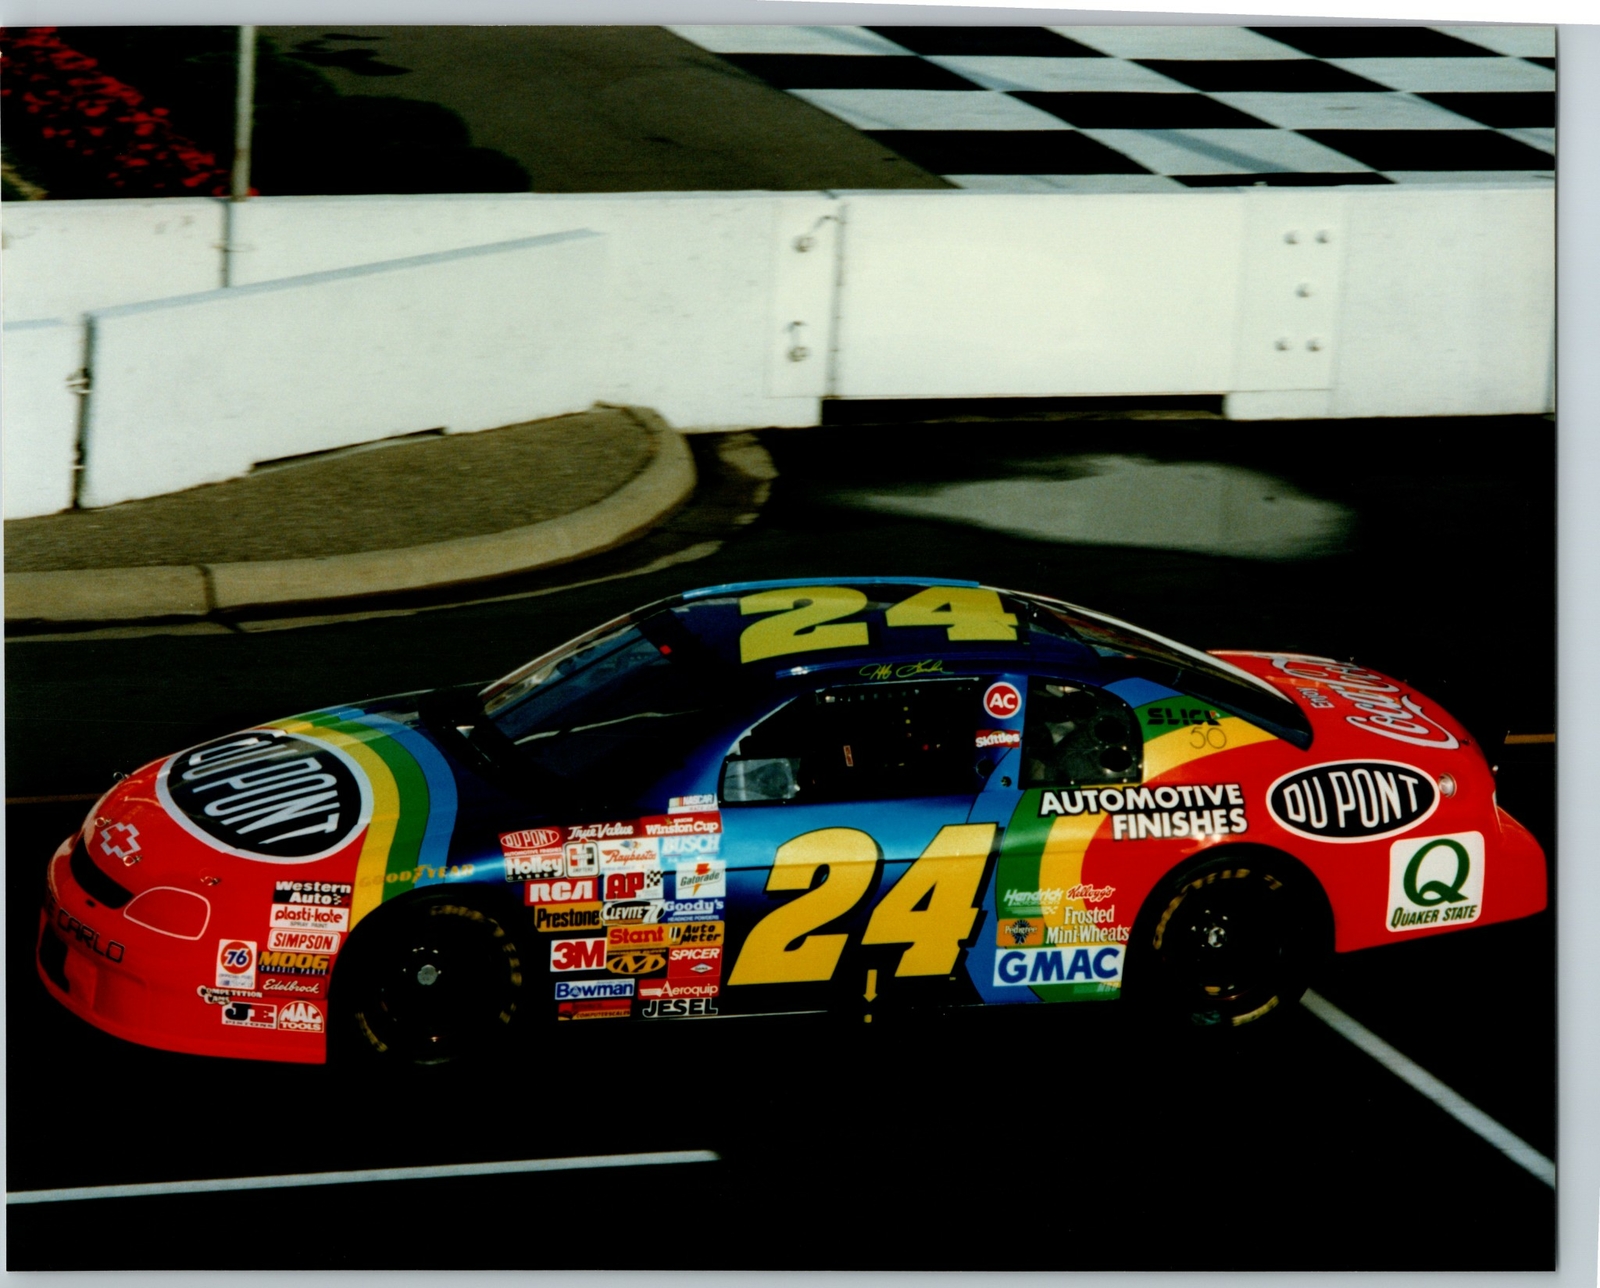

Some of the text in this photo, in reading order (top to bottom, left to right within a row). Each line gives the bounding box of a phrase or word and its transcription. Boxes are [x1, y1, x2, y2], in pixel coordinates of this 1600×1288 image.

[739, 586, 1018, 664] 24
[989, 692, 1017, 709] AC
[1146, 708, 1222, 726] SLICK
[975, 731, 1021, 748] Skittles
[1189, 727, 1227, 750] 50
[182, 737, 341, 845] DU PONT
[683, 794, 714, 804] NASCAR
[1040, 784, 1244, 816] AUTOMOTIVE
[1283, 768, 1419, 829] DU PONT
[567, 822, 633, 840] True Value
[645, 820, 719, 836] Winston Cup
[1113, 808, 1248, 841] FINISHES
[505, 830, 554, 847] DU PONT
[662, 834, 720, 855] BUSCH
[506, 855, 562, 876] Holley
[360, 864, 475, 888] GOODYEAR
[680, 870, 720, 887] Gatorade
[275, 881, 351, 893] Western
[529, 880, 593, 902] RCA
[605, 871, 645, 900] AP
[1066, 884, 1116, 902] Kellogg's
[289, 891, 333, 904] Auto
[727, 822, 997, 985] 24
[1004, 888, 1064, 906] Hendrick
[274, 906, 343, 923] plasti-kote
[602, 899, 665, 923] CLEVITE 77
[665, 899, 724, 915] Goody's
[1064, 905, 1115, 924] Frosted
[1390, 904, 1478, 928] QUAKER STATE
[536, 908, 600, 929] Prestone
[58, 907, 125, 964] CARLO
[610, 926, 664, 944] Stant
[683, 924, 715, 934] Auto
[1004, 925, 1038, 935] Pedigree
[273, 932, 334, 950] SIMPSON
[681, 933, 721, 945] Meter
[223, 949, 250, 967] 76
[258, 951, 330, 969] MOOG
[552, 939, 606, 970] 3M
[670, 947, 720, 960] SPICER
[300, 968, 326, 976] PARTS
[997, 947, 1120, 984] GMAC
[197, 985, 263, 998] COMPETITION
[263, 978, 319, 994] Edelbrock
[556, 983, 634, 998] Bowman
[659, 981, 719, 997] Aeroquip
[224, 1002, 275, 1024] JE
[280, 1002, 322, 1022] MAC
[643, 998, 718, 1018] JESEL
[281, 1022, 321, 1031] TOOLS
